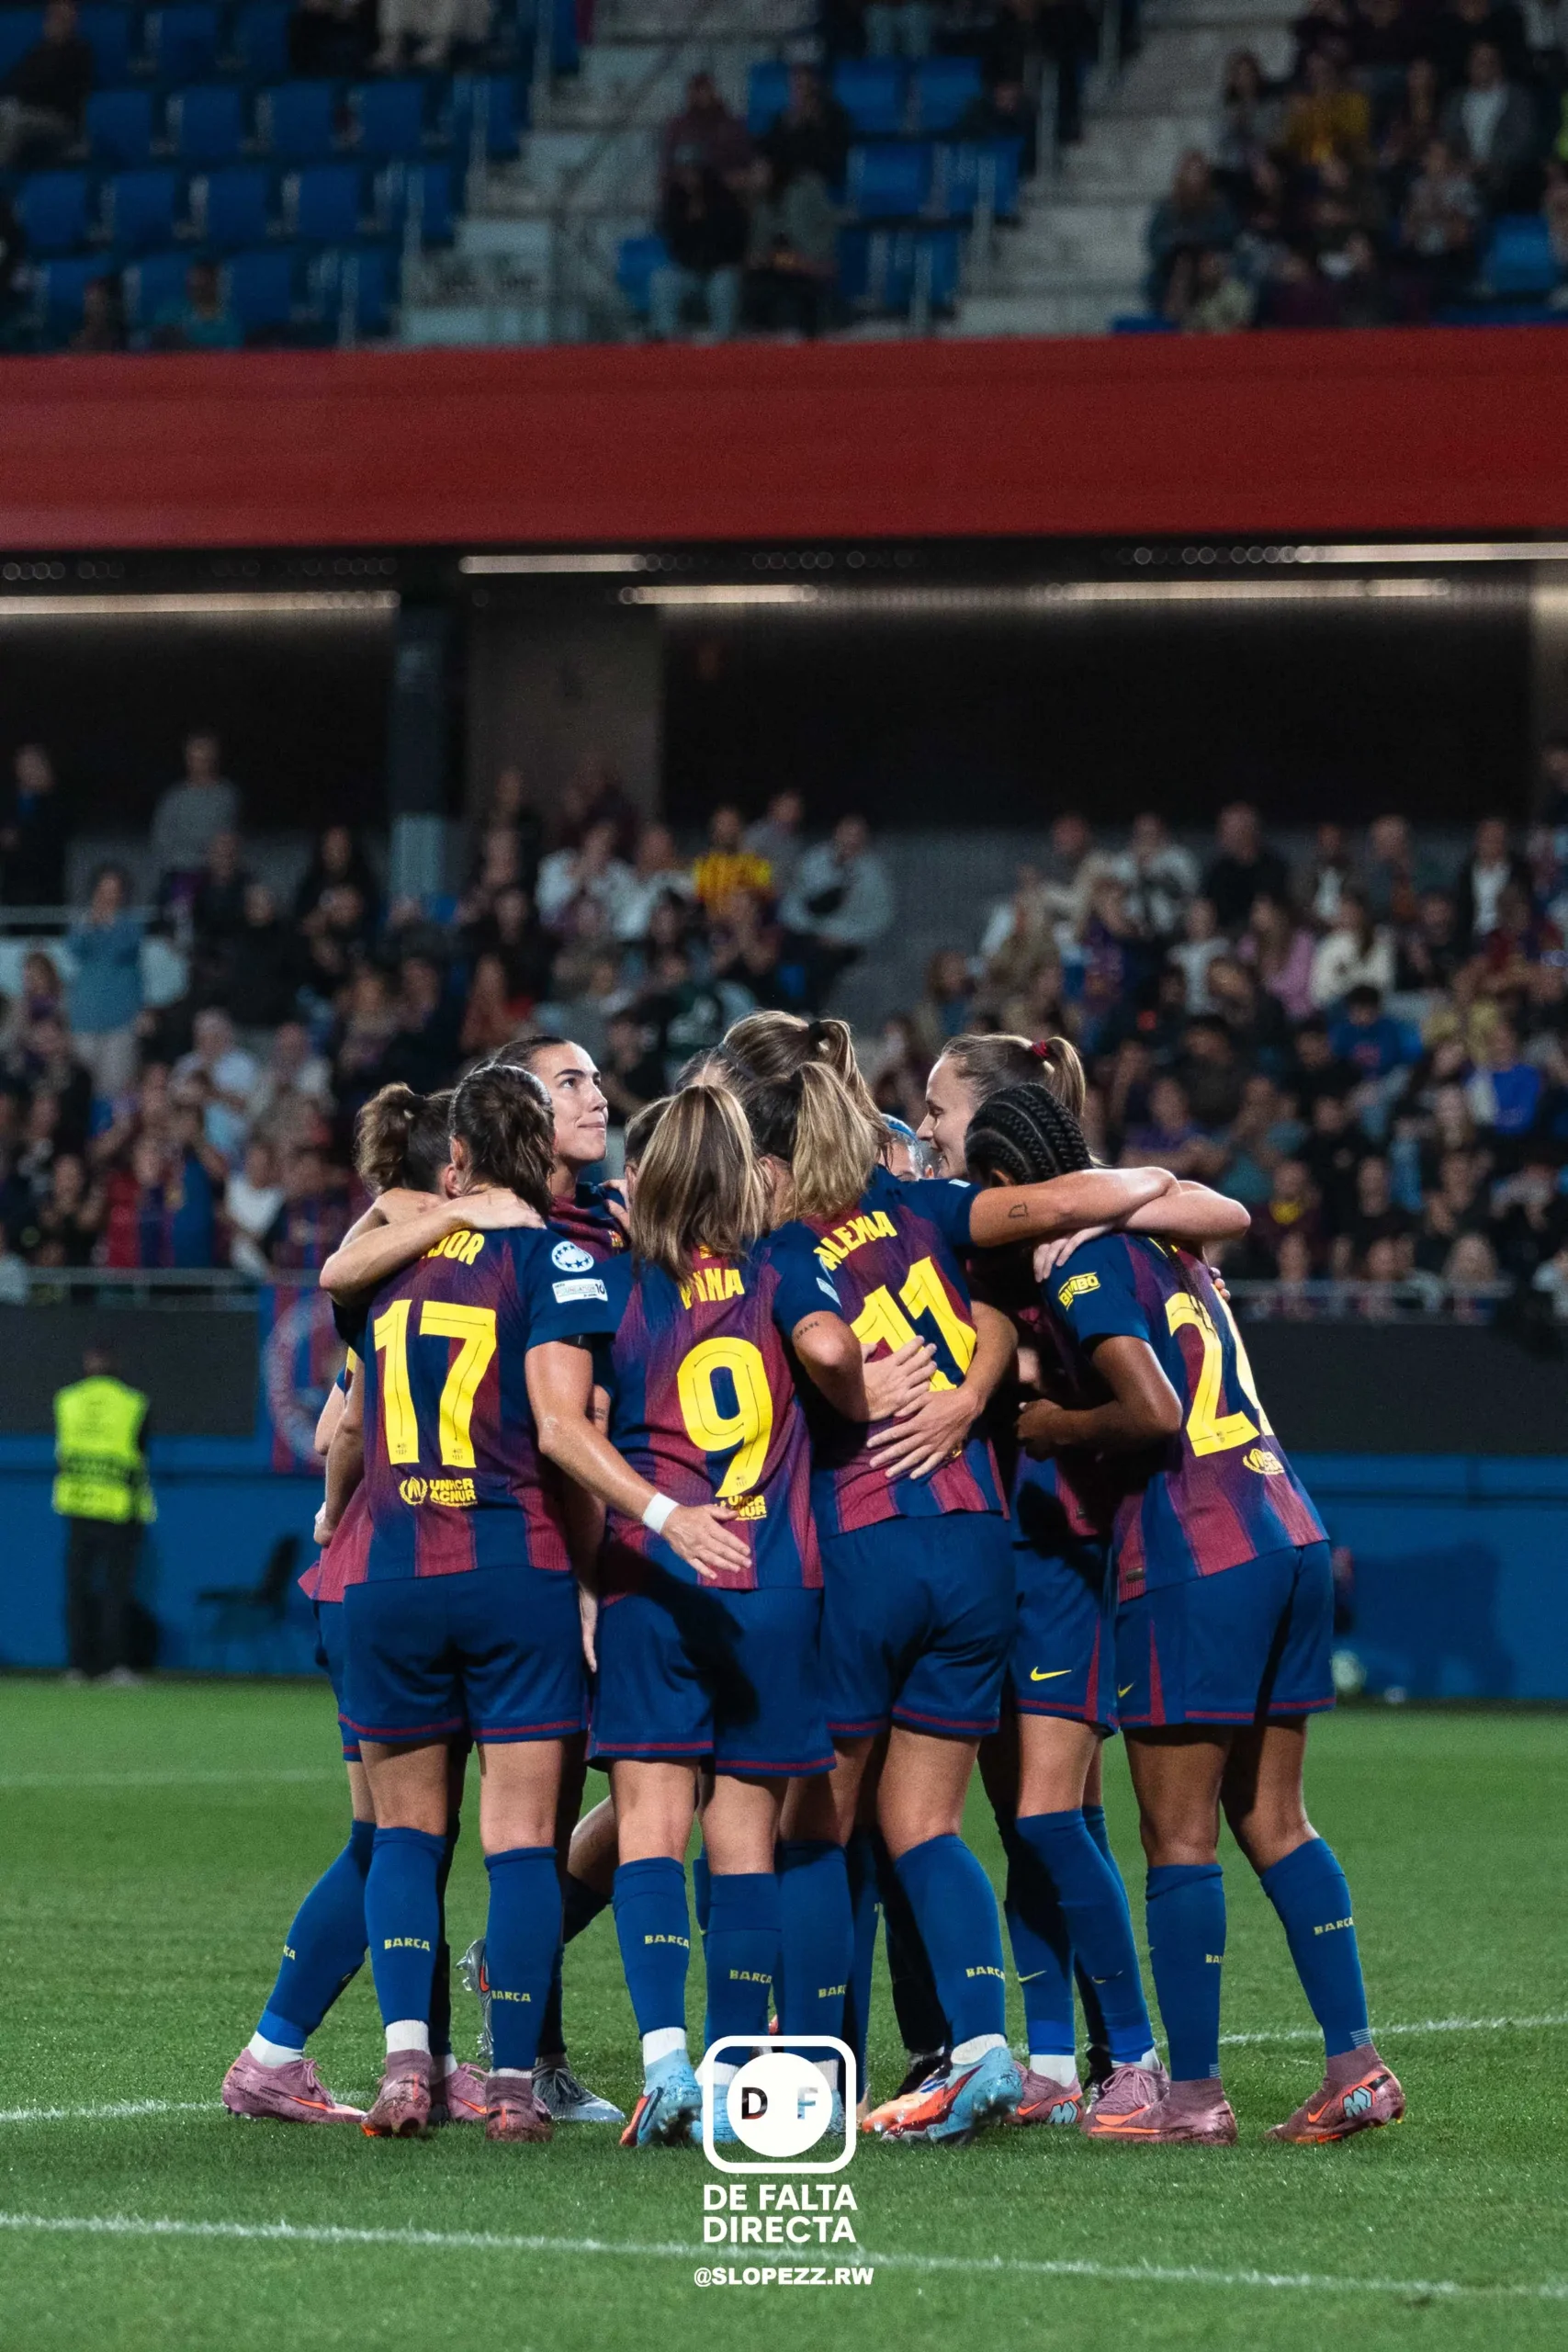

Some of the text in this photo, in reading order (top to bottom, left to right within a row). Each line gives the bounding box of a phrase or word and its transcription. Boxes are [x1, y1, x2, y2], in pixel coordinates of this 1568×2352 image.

[427, 1229, 485, 1266] JOR
[813, 1211, 897, 1272] ALEXIA
[374, 1299, 496, 1468] 17
[677, 1336, 773, 1498] 9
[429, 1489, 477, 1502] ACNUR
